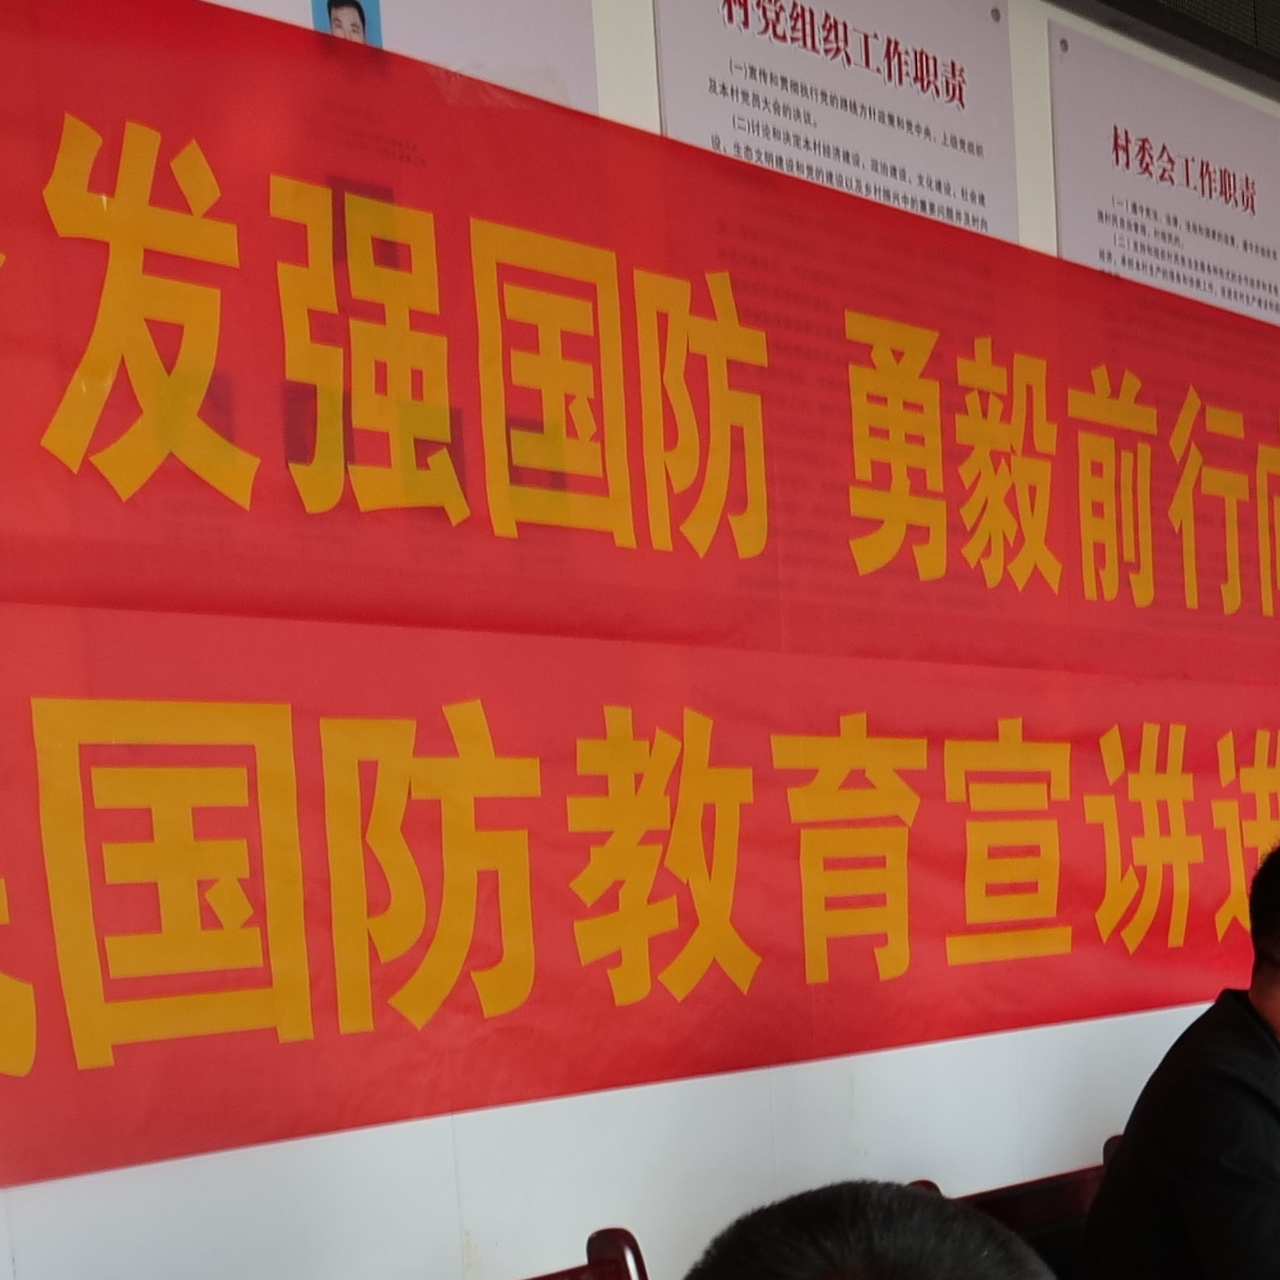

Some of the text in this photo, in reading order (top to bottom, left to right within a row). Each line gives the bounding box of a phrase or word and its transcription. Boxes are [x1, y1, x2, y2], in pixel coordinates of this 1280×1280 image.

[721, 0, 967, 109] 村党组织工作职责
[1111, 122, 1258, 218] 村委会工作职责
[0, 112, 768, 561] 发强国防
